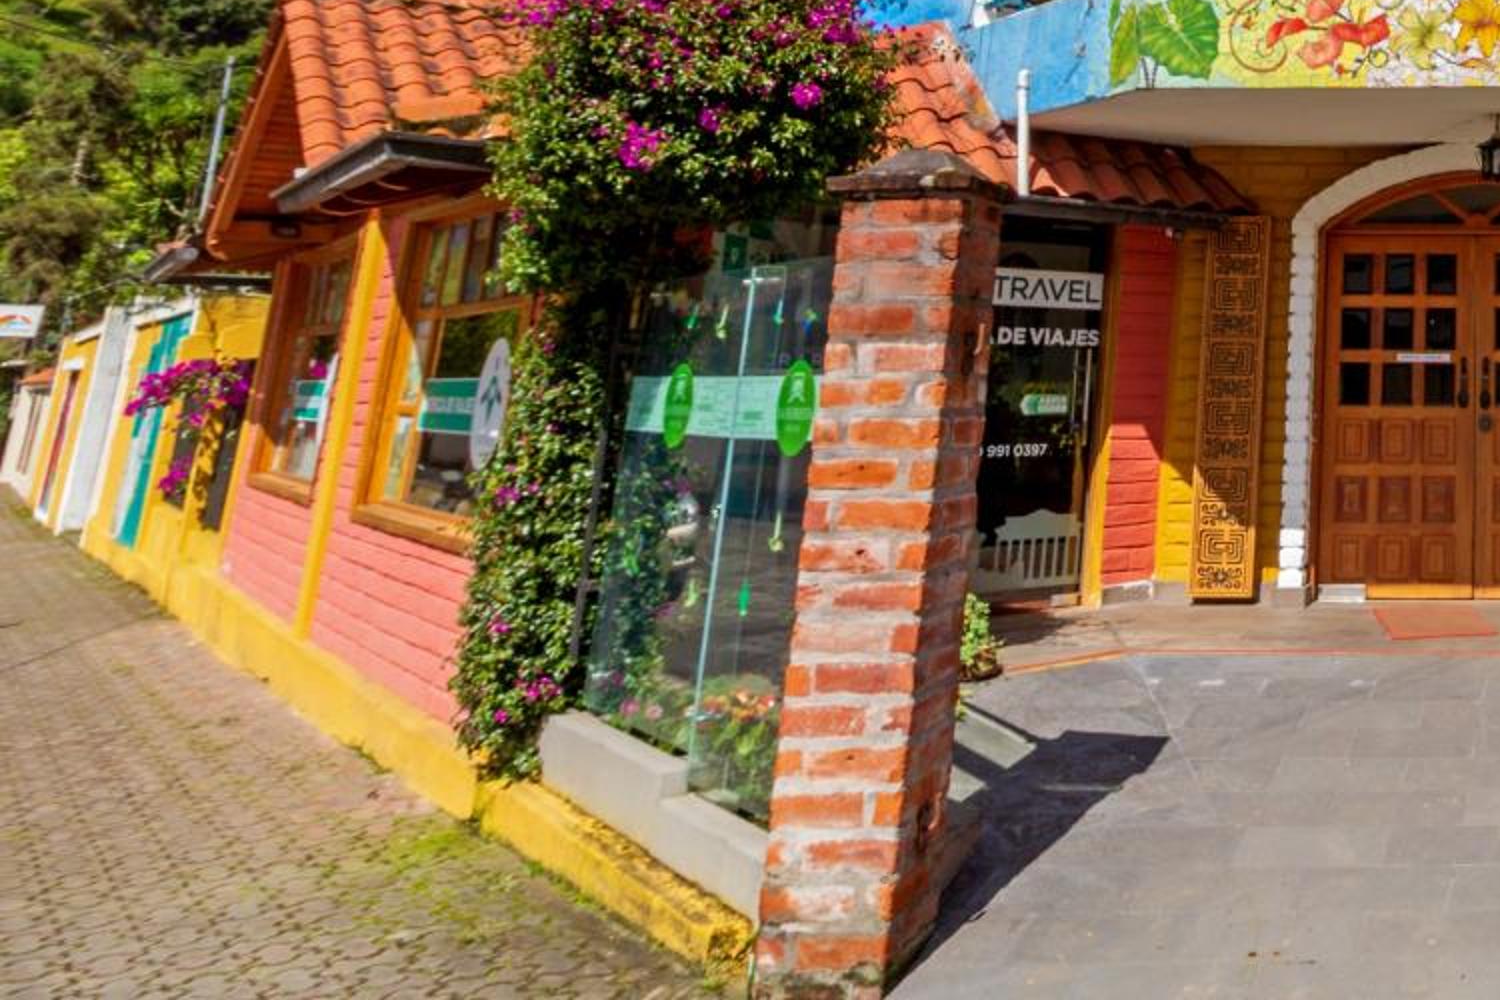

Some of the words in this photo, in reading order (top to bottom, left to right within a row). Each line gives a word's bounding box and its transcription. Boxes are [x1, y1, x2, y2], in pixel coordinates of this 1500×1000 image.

[994, 275, 1100, 303] TRAVEL
[998, 326, 1027, 345] DE
[1029, 327, 1100, 346] VIAJES
[987, 444, 1010, 458] 991
[1013, 443, 1048, 457] 0397
